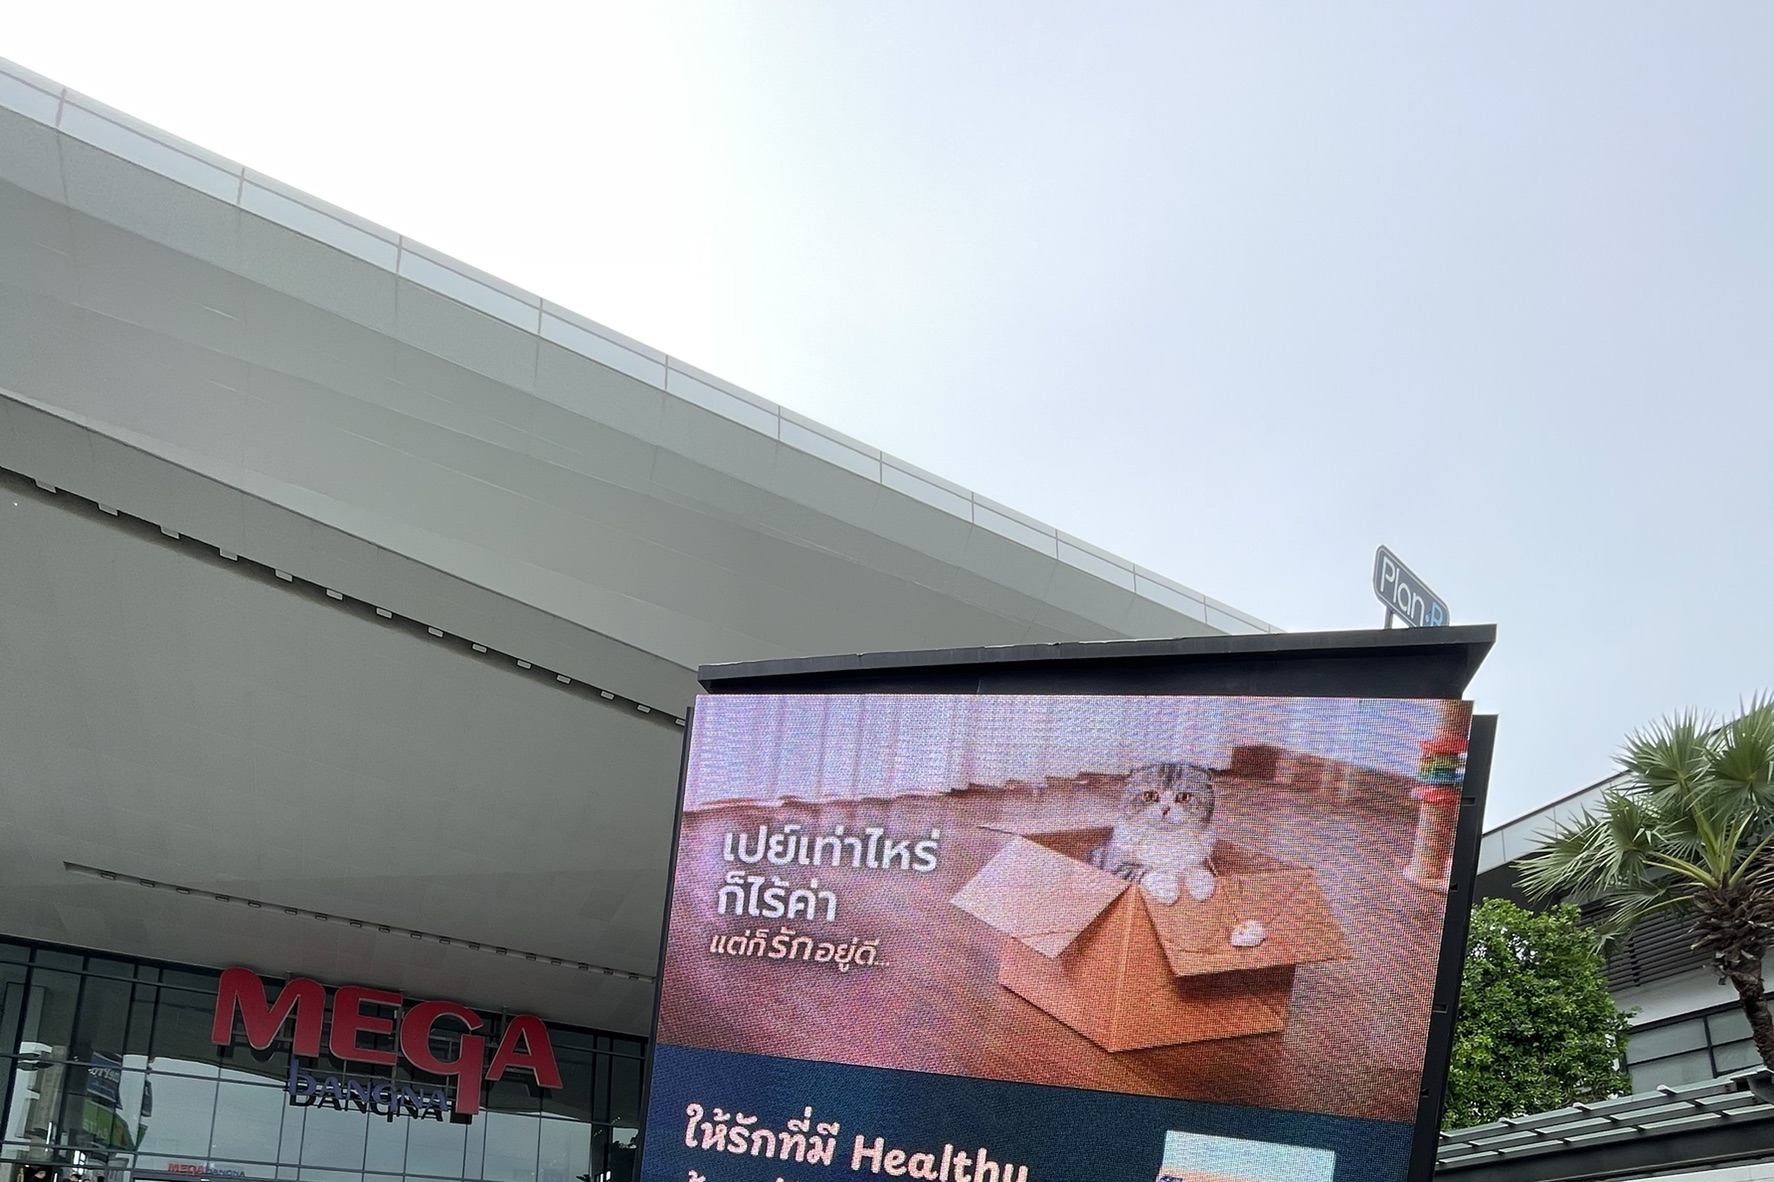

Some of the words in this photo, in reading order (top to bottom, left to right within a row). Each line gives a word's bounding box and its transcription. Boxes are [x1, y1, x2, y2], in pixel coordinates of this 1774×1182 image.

[723, 825, 941, 872] เปย์เท่าไหร่
[717, 870, 838, 922] ก็ไร้ค่า
[211, 967, 564, 1115] MEGA
[685, 1103, 841, 1166] ให้รักที่มี
